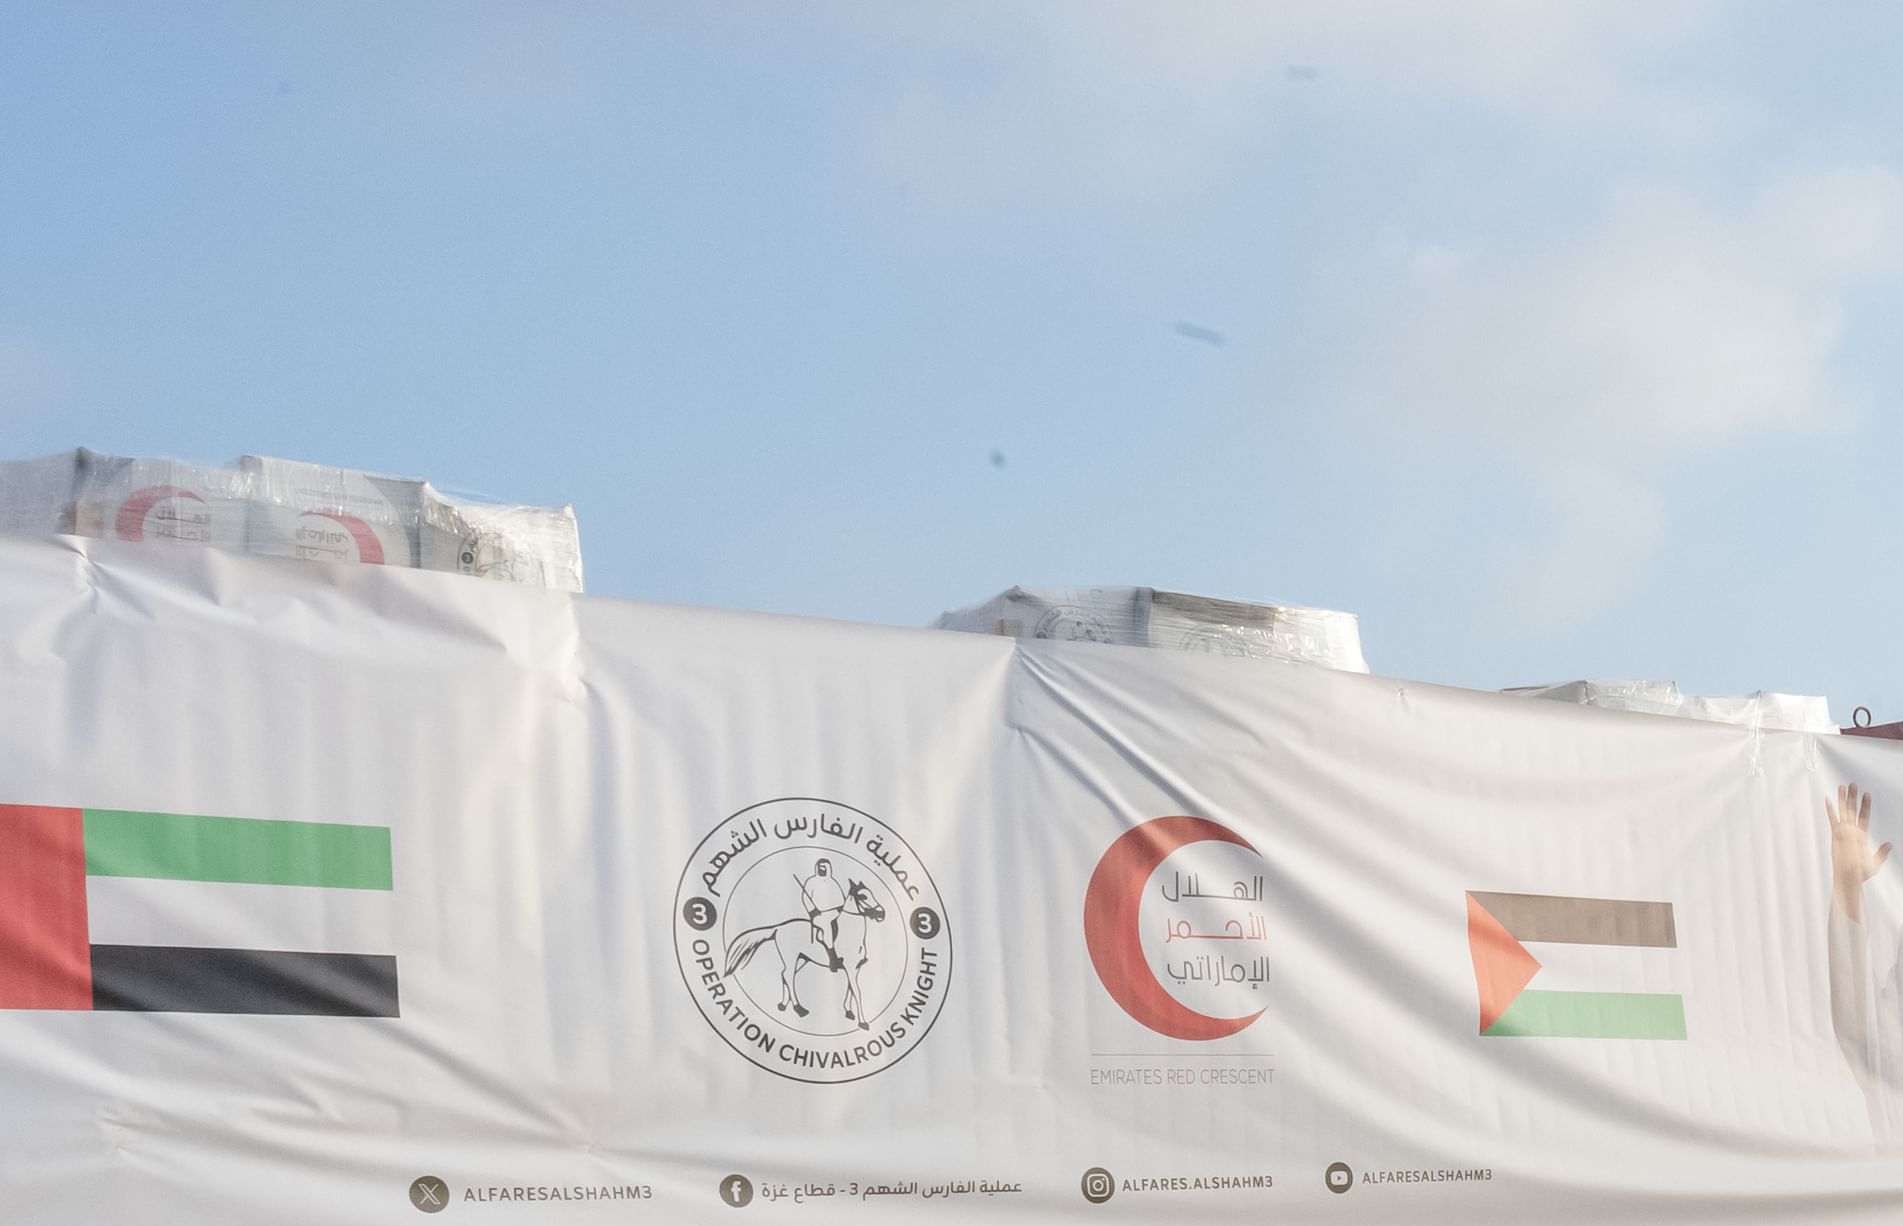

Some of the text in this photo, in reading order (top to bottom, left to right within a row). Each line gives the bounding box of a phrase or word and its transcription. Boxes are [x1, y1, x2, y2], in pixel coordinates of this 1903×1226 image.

[702, 813, 920, 901] عملية الفارس الشهم
[1161, 871, 1264, 902] الهلال
[1166, 911, 1268, 943] الأحمر
[1167, 955, 1271, 990] الإماراتي
[692, 938, 938, 1069] OPERATION CHIVALROUS KNIGHT
[1090, 1067, 1275, 1086] EMIRATES RED CRESCENT
[1121, 1174, 1275, 1193] ALFARES.ALSHAHM3
[1362, 1168, 1494, 1185] ALFARESALSHAHM3
[463, 1183, 653, 1203] ALFARESALSHAHM3
[761, 1181, 789, 1201] غزة
[794, 1182, 836, 1204] قطاع
[849, 1182, 859, 1196] 3
[862, 1181, 919, 1200] الشهم
[921, 1180, 976, 1199] الفارس
[979, 1179, 1023, 1197] عملية
